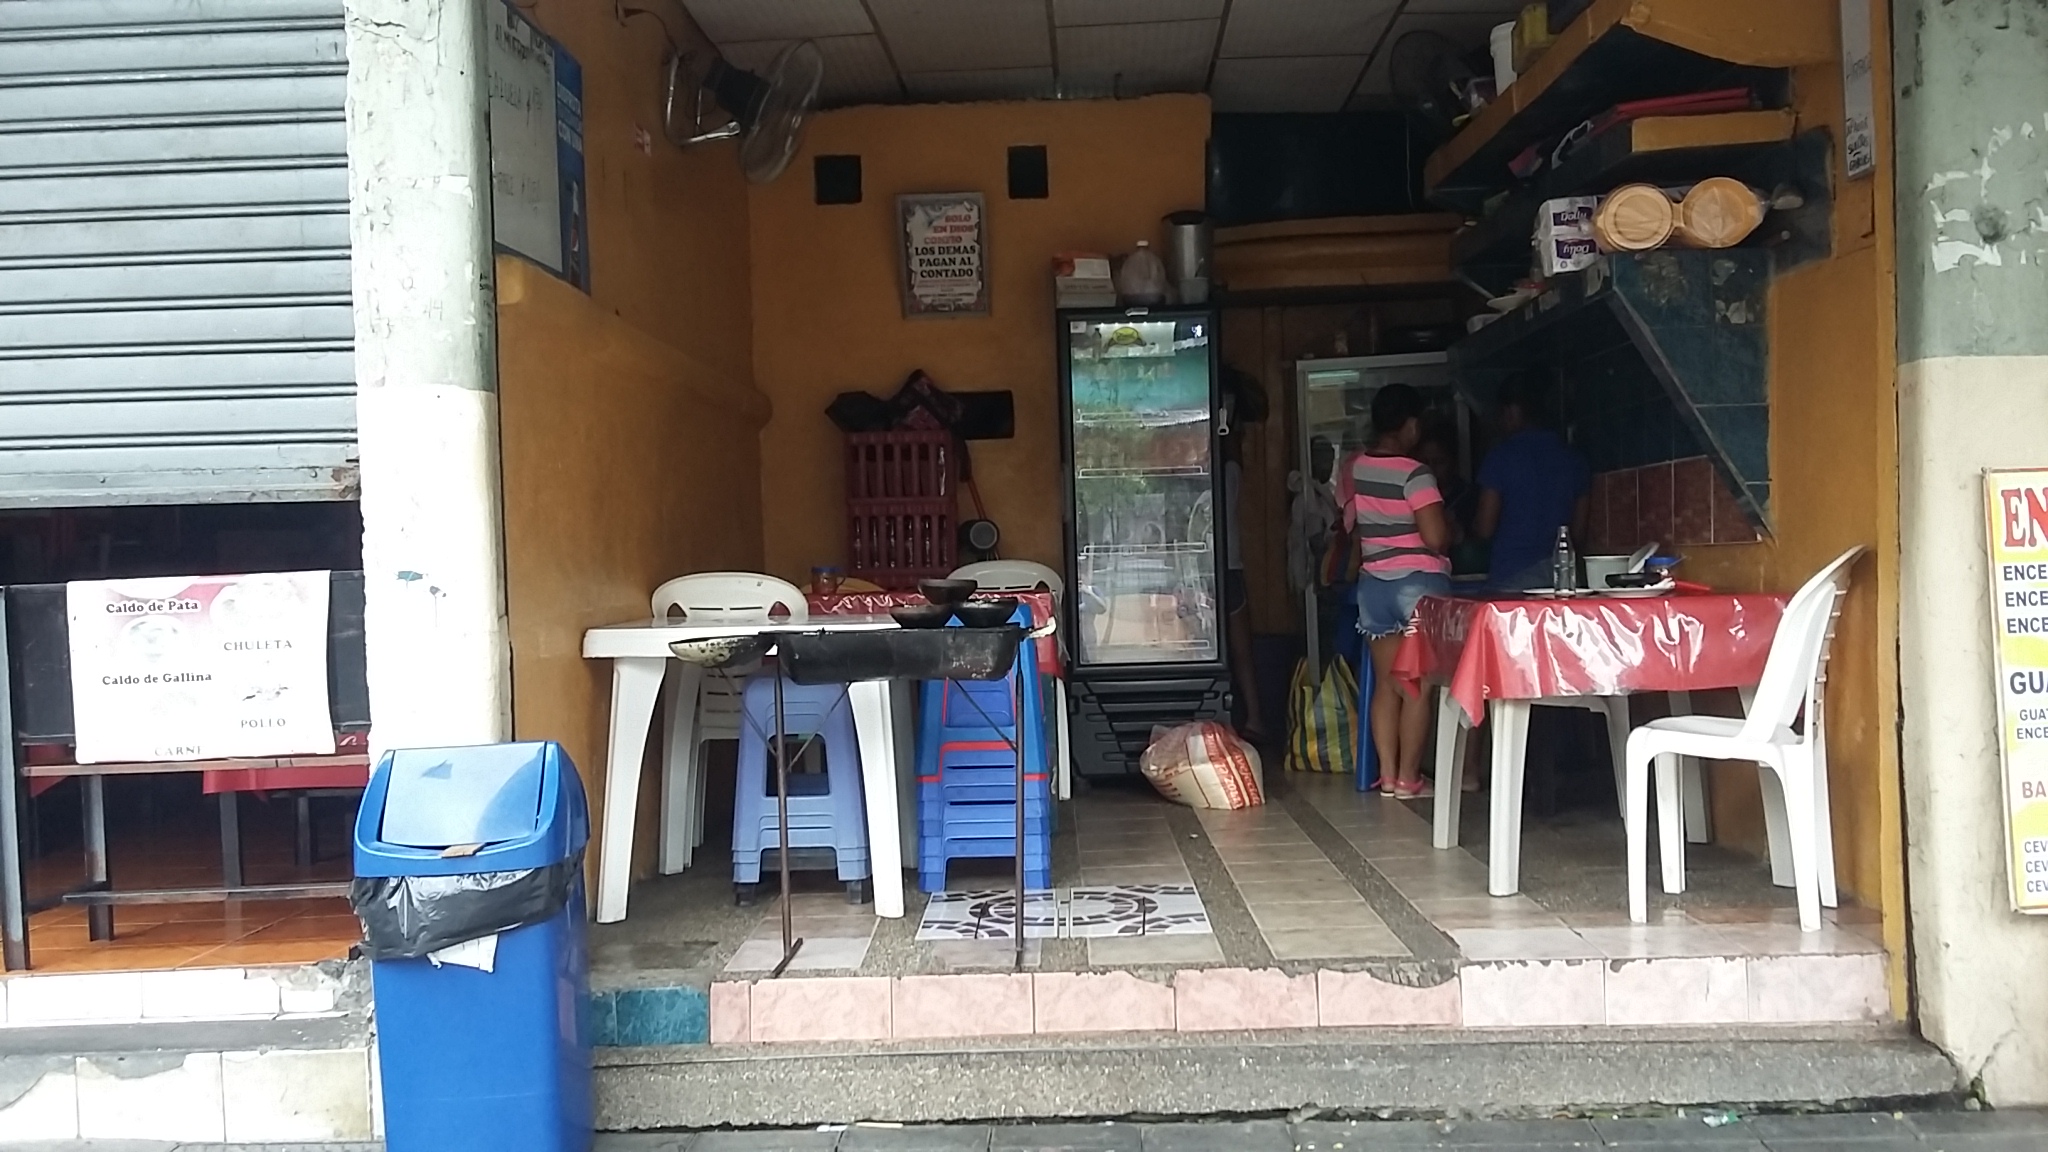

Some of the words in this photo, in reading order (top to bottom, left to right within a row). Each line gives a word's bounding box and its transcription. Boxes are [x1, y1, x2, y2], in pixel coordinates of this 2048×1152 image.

[933, 225, 948, 234] EN
[914, 246, 936, 256] LOS
[937, 245, 977, 255] DEMAS
[919, 257, 957, 268] PAGAN
[959, 256, 974, 266] AL
[920, 268, 974, 279] CONTADO
[2003, 563, 2048, 582] ENCE
[2004, 590, 2048, 608] ENCE
[105, 602, 145, 614] Caldo
[148, 601, 165, 612] de
[167, 600, 199, 612] Pata
[2006, 616, 2048, 634] ENCE
[223, 639, 293, 652] CHULETA
[101, 674, 140, 686] Caldo
[143, 673, 159, 684] de
[162, 672, 212, 684] Gallina
[2009, 671, 2048, 695] GU
[2016, 727, 2048, 740] ENCE
